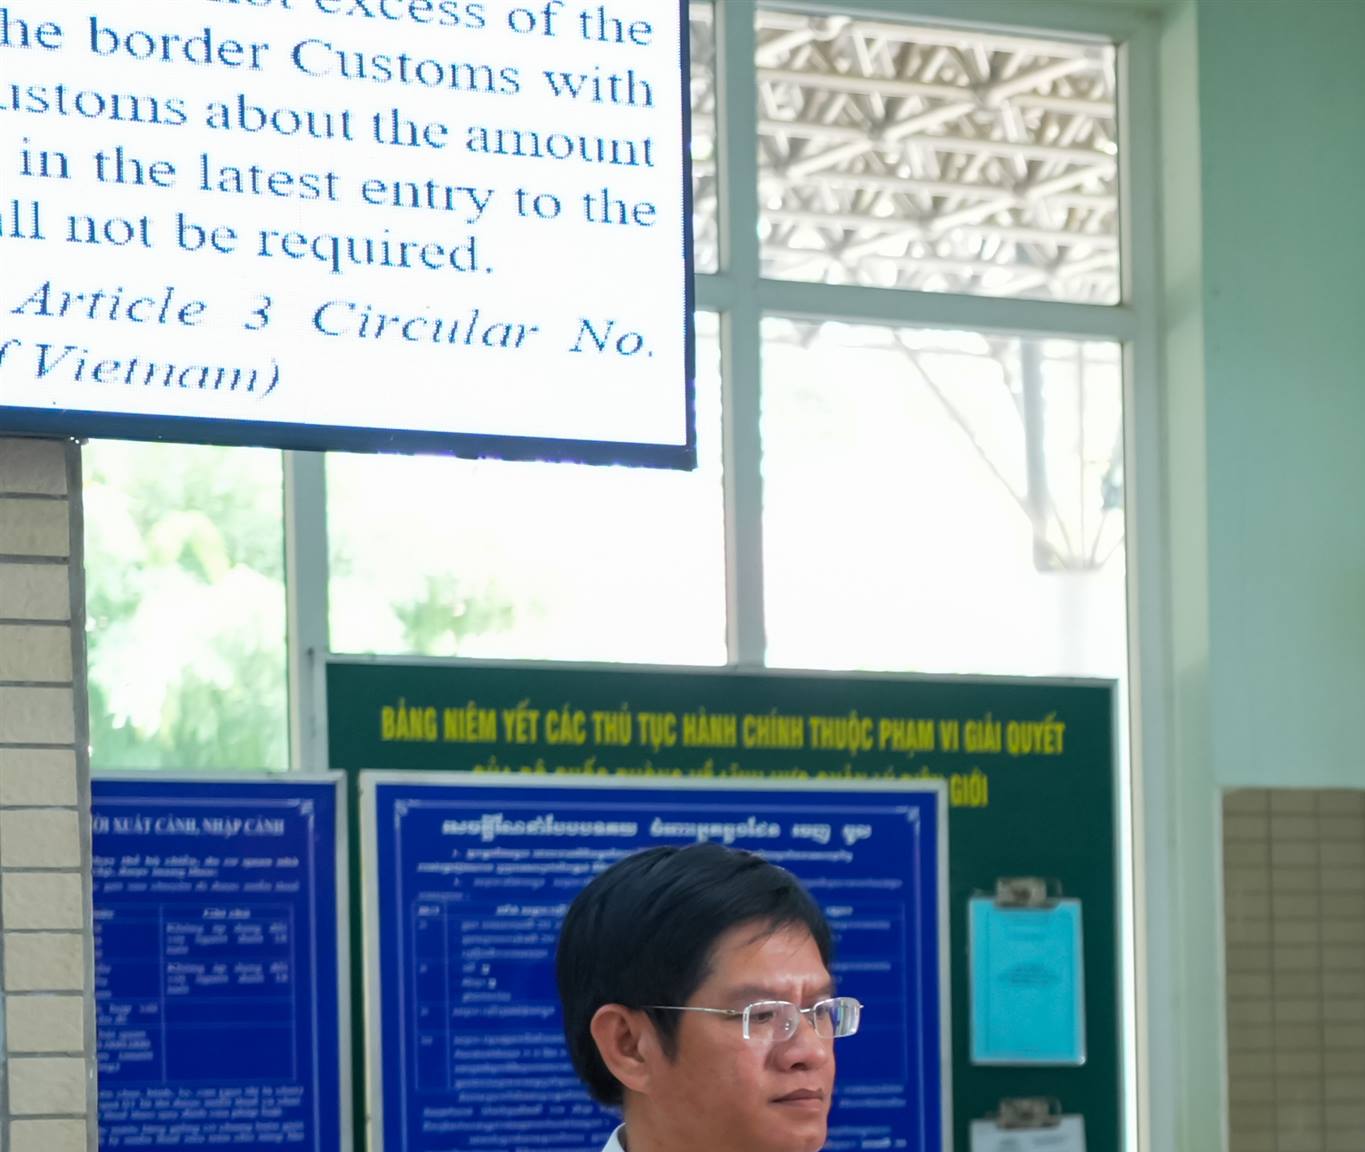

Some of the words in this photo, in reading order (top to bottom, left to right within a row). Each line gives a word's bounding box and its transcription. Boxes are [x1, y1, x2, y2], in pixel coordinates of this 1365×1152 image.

[0, 8, 63, 50] he
[90, 17, 269, 70] border
[292, 39, 520, 95] Customs
[543, 66, 655, 108] with
[508, 0, 565, 36] of
[580, 5, 652, 45] the
[0, 83, 187, 125] ustoms
[207, 94, 352, 141] about
[373, 108, 448, 148] the
[466, 126, 655, 167] amount
[20, 136, 71, 179] in
[94, 145, 176, 187] the
[200, 153, 340, 200] latest
[362, 178, 495, 225] entry
[516, 188, 562, 219] to
[583, 188, 656, 227] the
[0, 199, 46, 239] ll
[67, 215, 152, 248] not
[176, 213, 238, 253] be
[258, 229, 493, 275] required.
[10, 281, 208, 326] Article
[244, 295, 272, 329] 3
[313, 301, 540, 348] Circular
[569, 317, 652, 358] No.
[35, 343, 280, 400] Vietnam)
[381, 697, 438, 741] BẢNG
[444, 700, 497, 742] NIÊM
[503, 699, 539, 744] YẾT
[546, 703, 586, 745] CÁC
[593, 702, 632, 746] THỦ
[638, 713, 677, 753] TỤC
[683, 706, 737, 748] HÀNH
[743, 707, 804, 749] CHÍNH
[810, 710, 873, 757] THUỘC
[879, 719, 934, 759] PHẠM
[940, 720, 959, 751] VI
[964, 712, 1002, 753] GIẢI
[1007, 712, 1065, 755] QUYẾT
